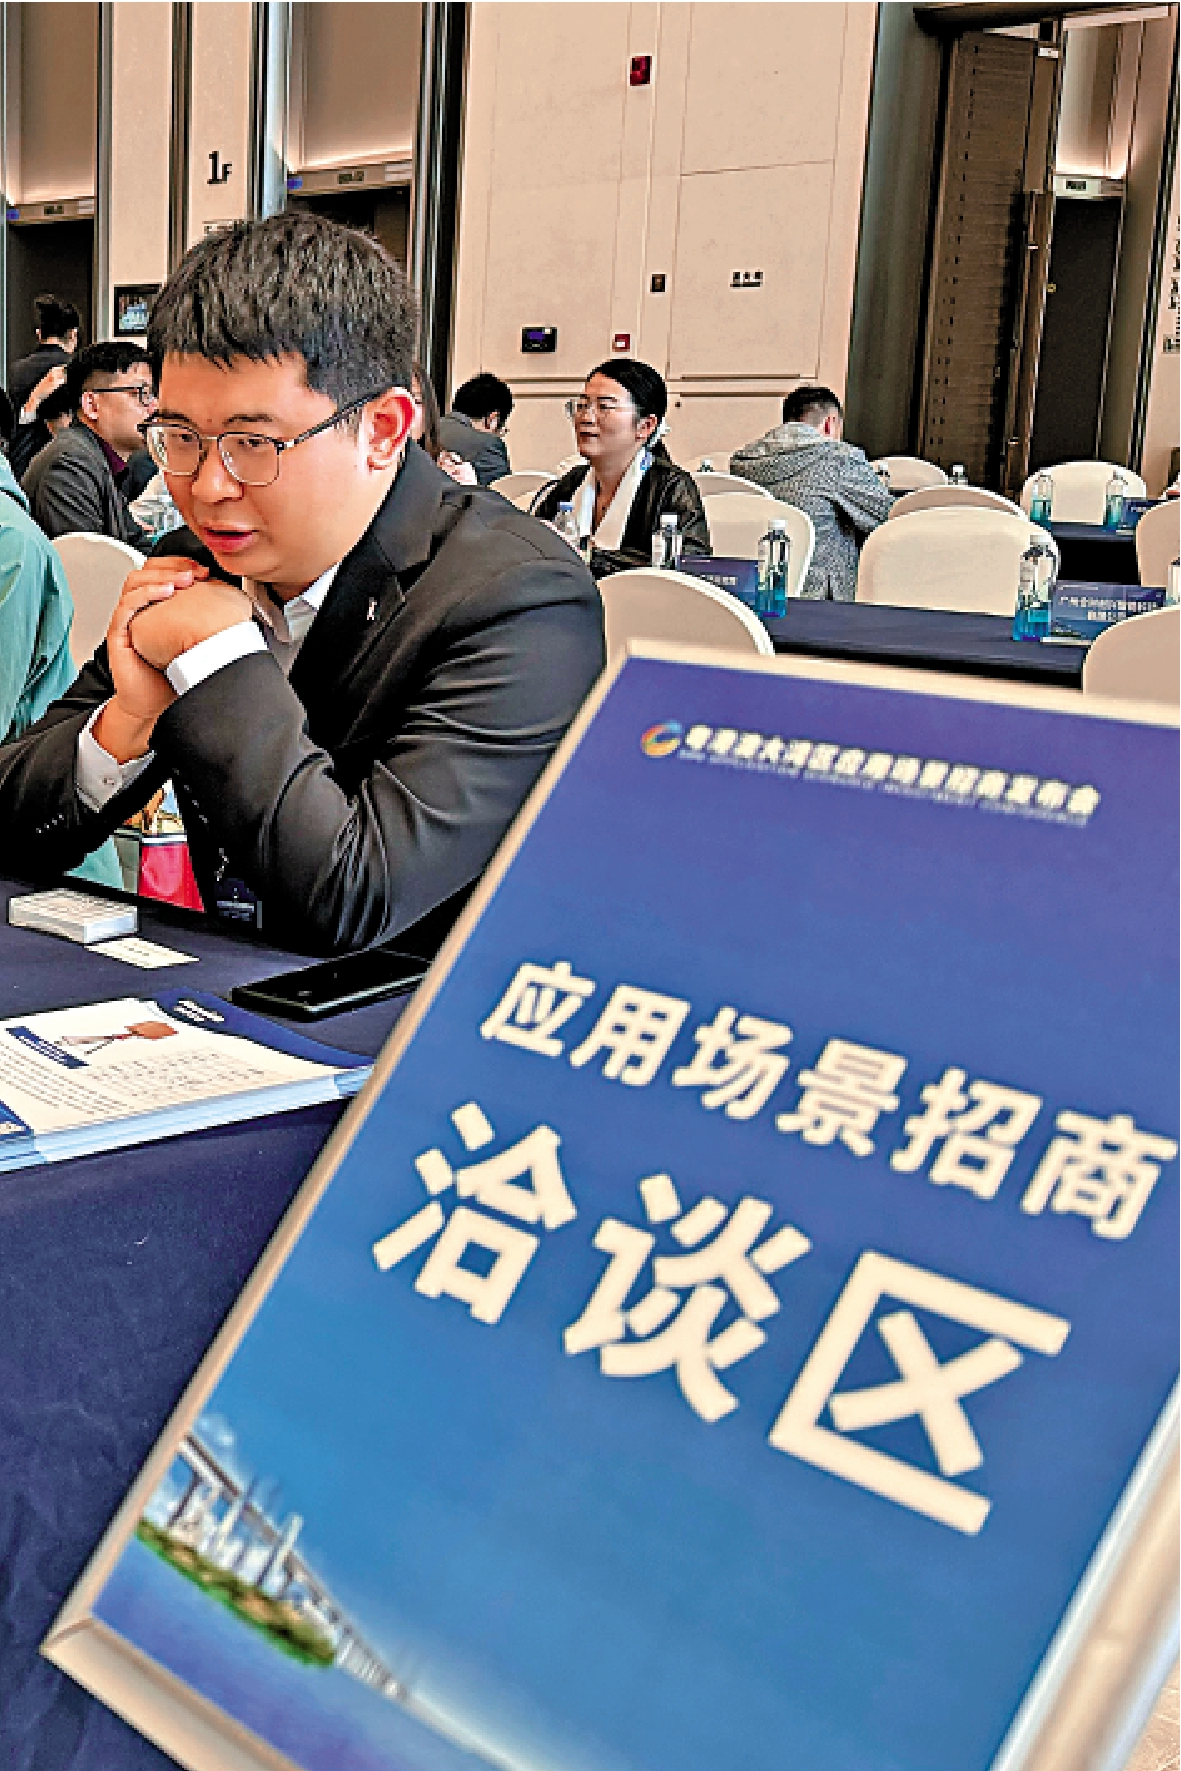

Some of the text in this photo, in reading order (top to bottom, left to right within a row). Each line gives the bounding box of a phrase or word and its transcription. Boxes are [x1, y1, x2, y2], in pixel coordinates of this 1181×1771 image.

[207, 150, 232, 184] 1F
[684, 723, 1101, 817] 粤港澳大湾区应用场景招商发布会
[479, 960, 1179, 1240] 应用场景招商
[372, 1100, 1071, 1536] 洽谈区
